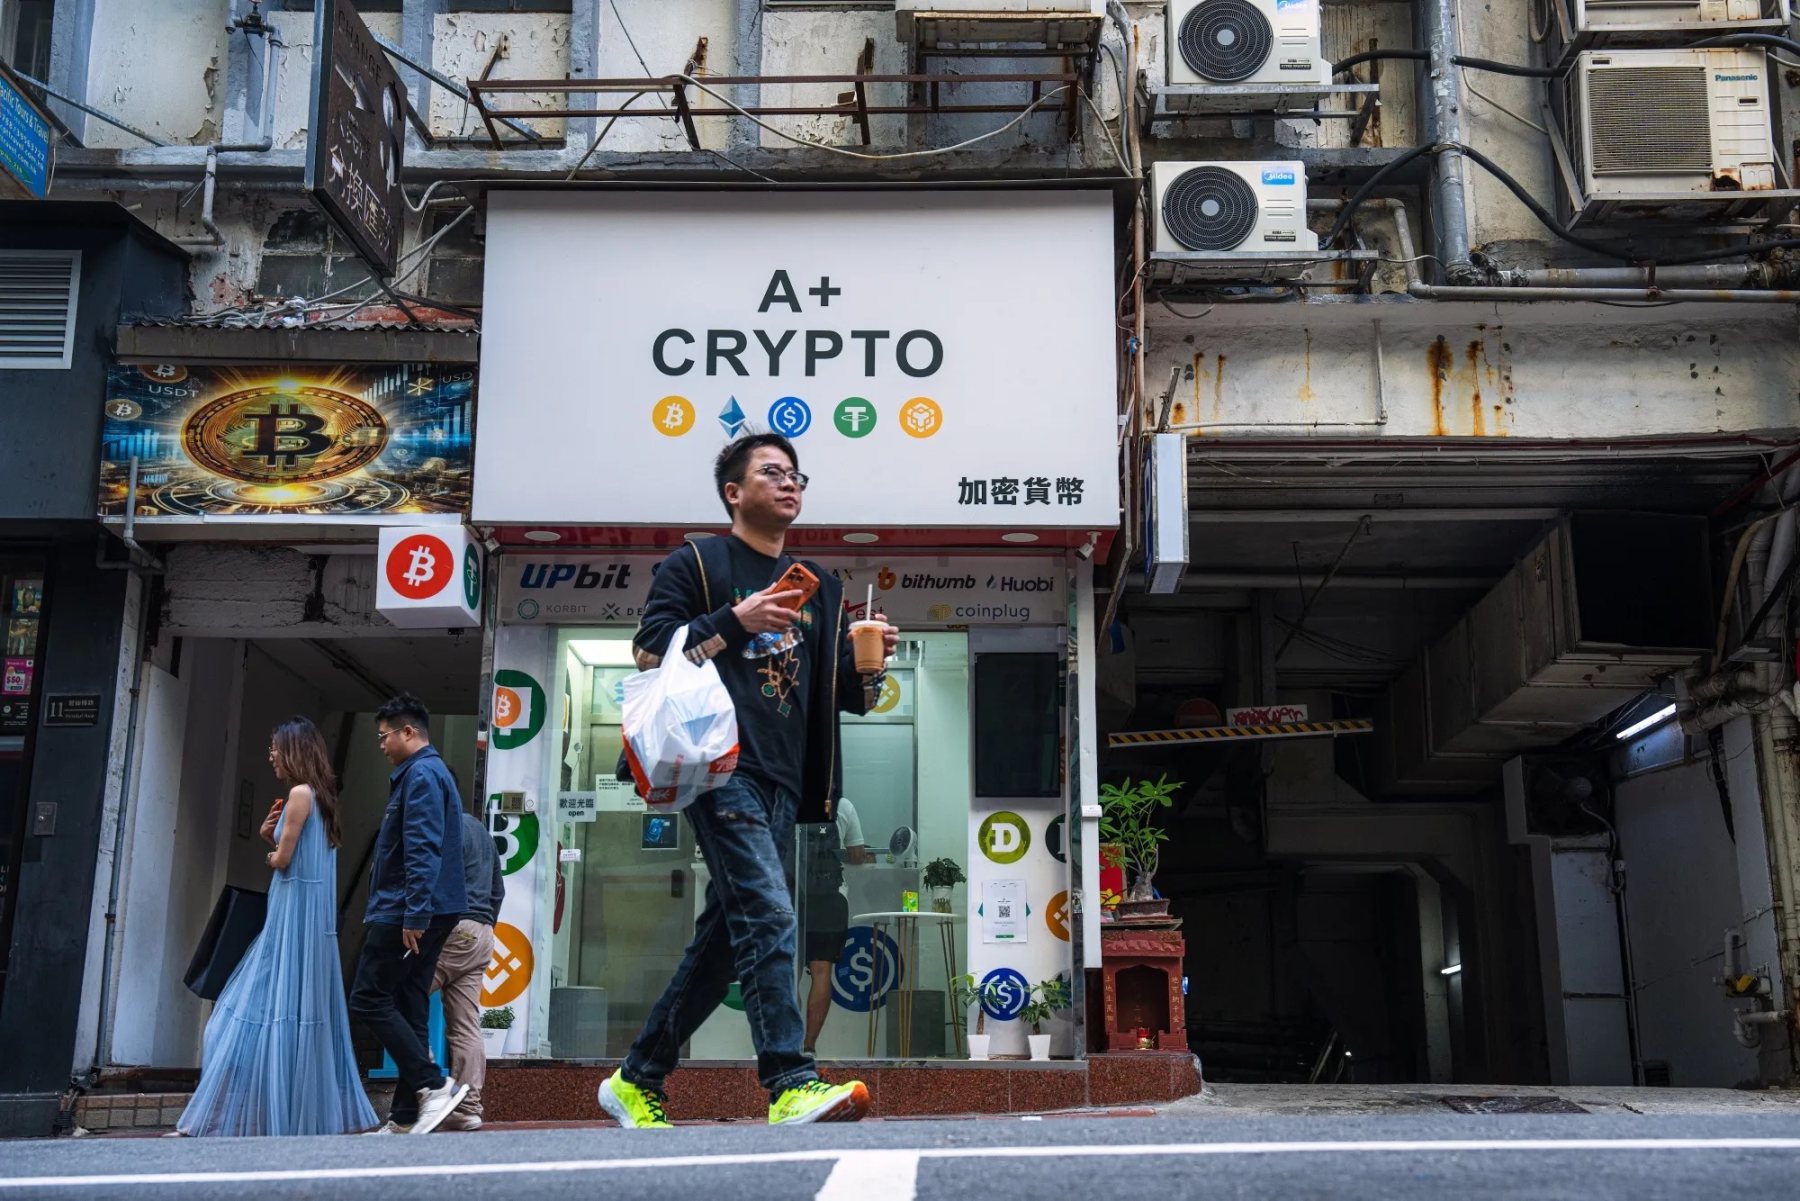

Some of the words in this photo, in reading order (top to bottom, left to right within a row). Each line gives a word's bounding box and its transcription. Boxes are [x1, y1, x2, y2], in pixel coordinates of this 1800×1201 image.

[757, 269, 841, 313] A+
[652, 328, 944, 378] CRYPTO
[148, 385, 199, 398] USDT
[958, 477, 1084, 506] 加密貨幣
[902, 573, 976, 590] bithumb
[1001, 576, 1054, 592] Huobi
[546, 604, 588, 613] KORBIT
[955, 603, 1030, 621] coinplug
[50, 702, 64, 718] 11
